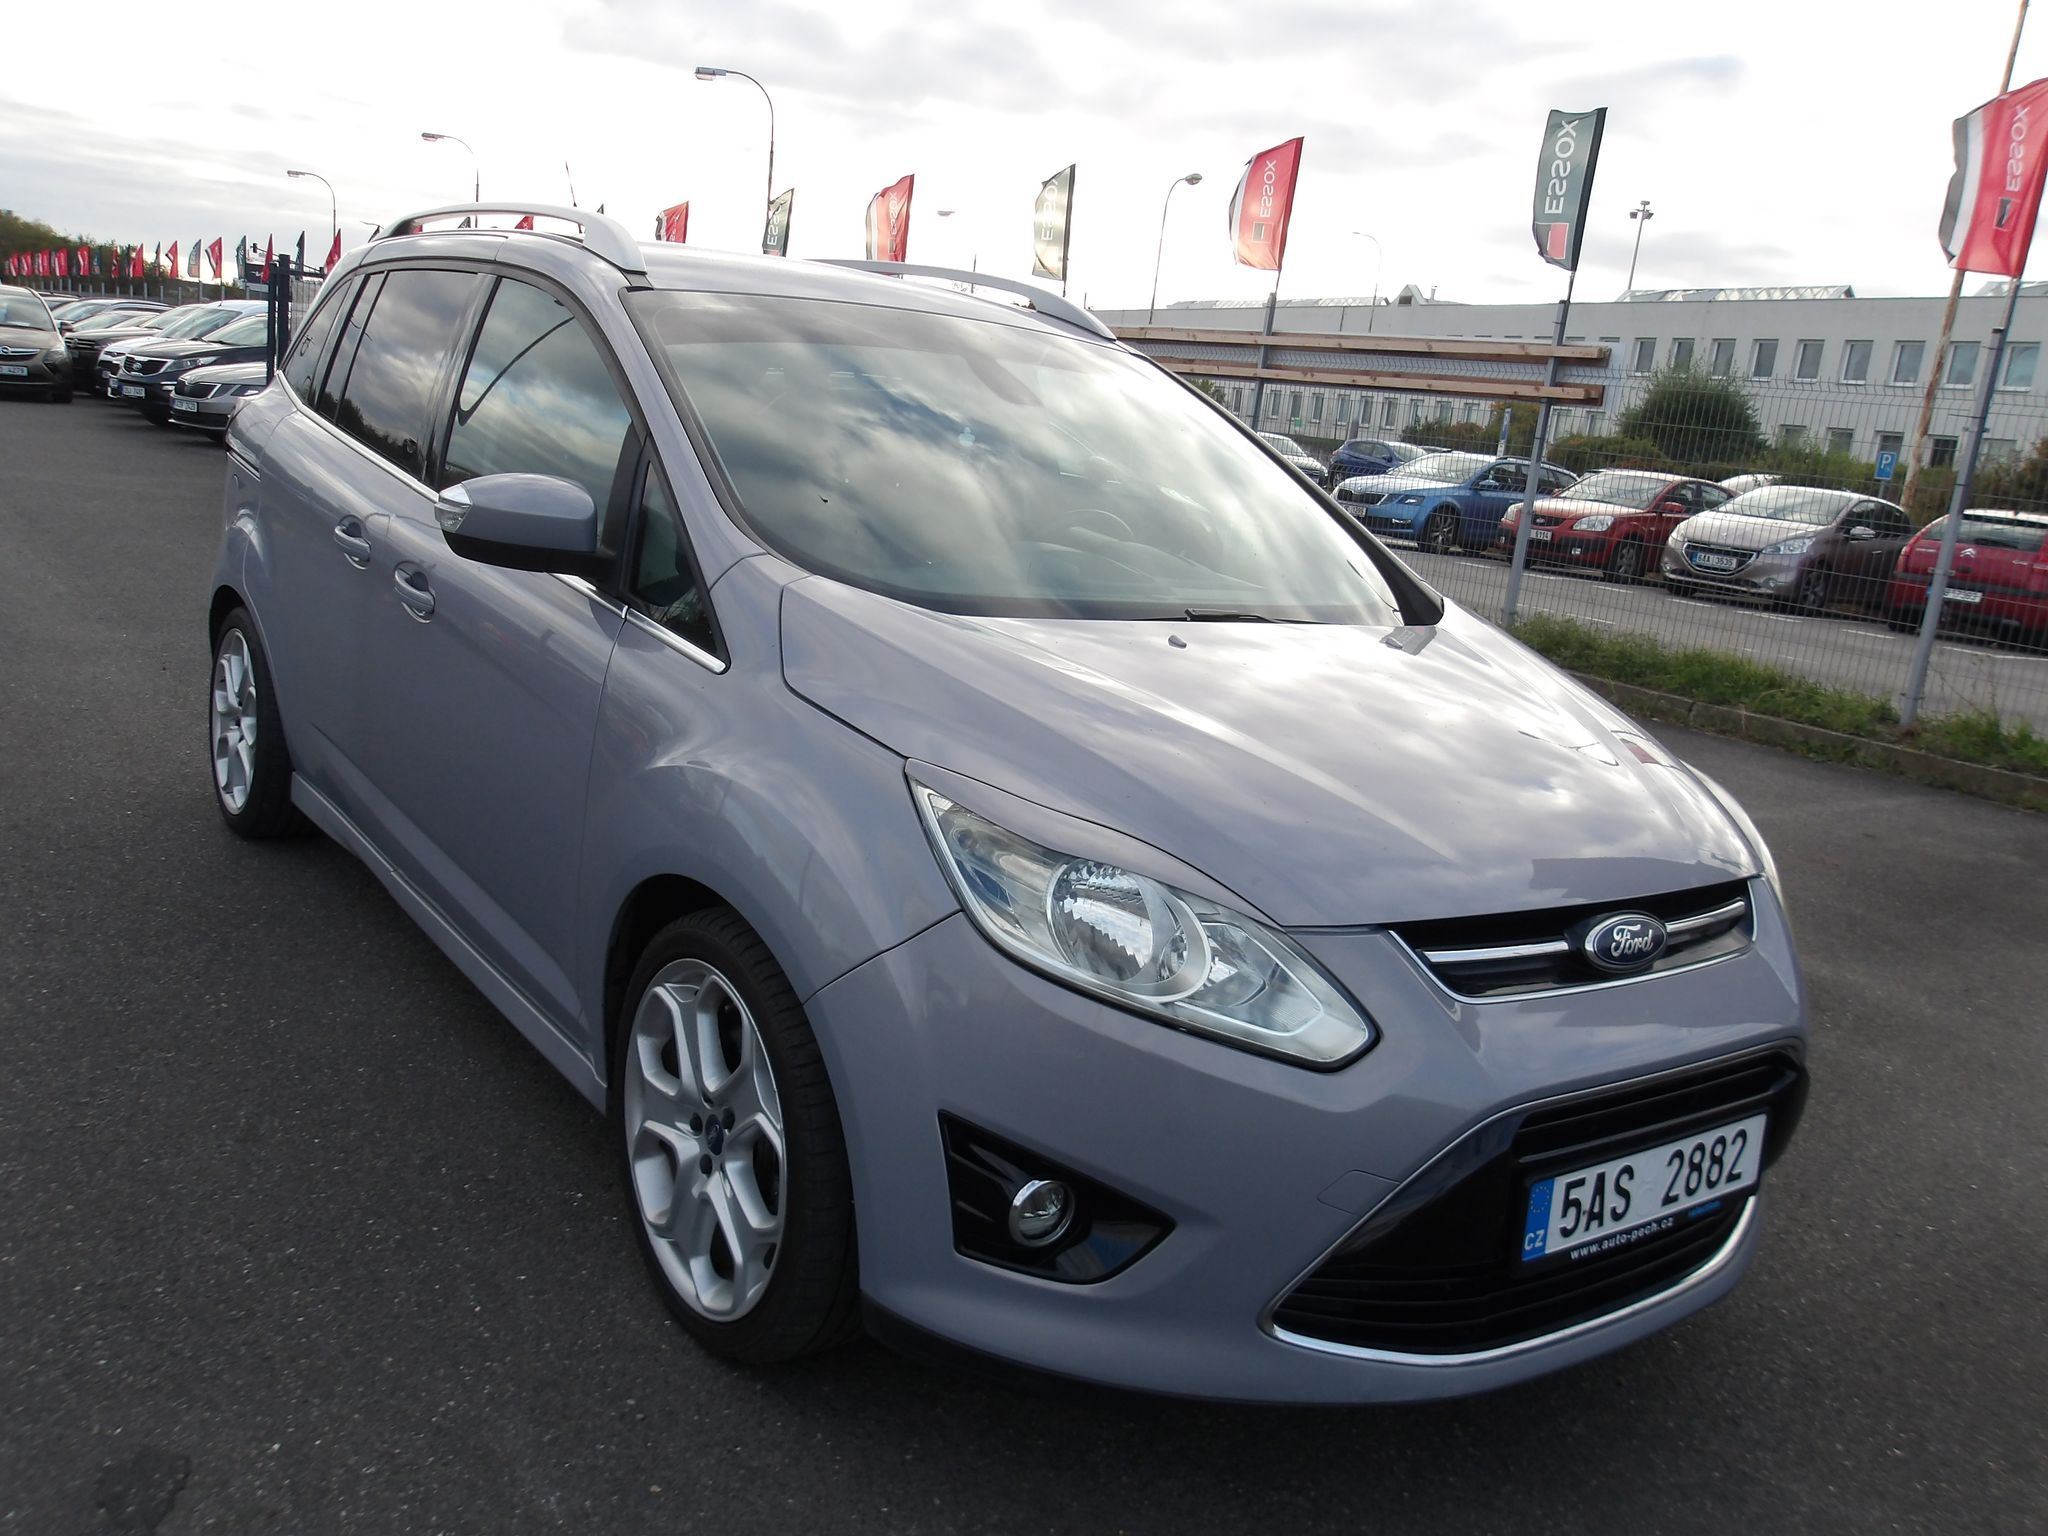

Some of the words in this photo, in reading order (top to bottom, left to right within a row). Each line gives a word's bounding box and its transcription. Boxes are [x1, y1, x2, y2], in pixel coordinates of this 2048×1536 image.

[1610, 924, 1654, 957] Ford
[1559, 1164, 1635, 1238] 5AS
[1661, 1128, 1748, 1207] 2882
[1525, 1229, 1544, 1252] CZ
[1570, 1216, 1675, 1260] www.auto-pech.cz
